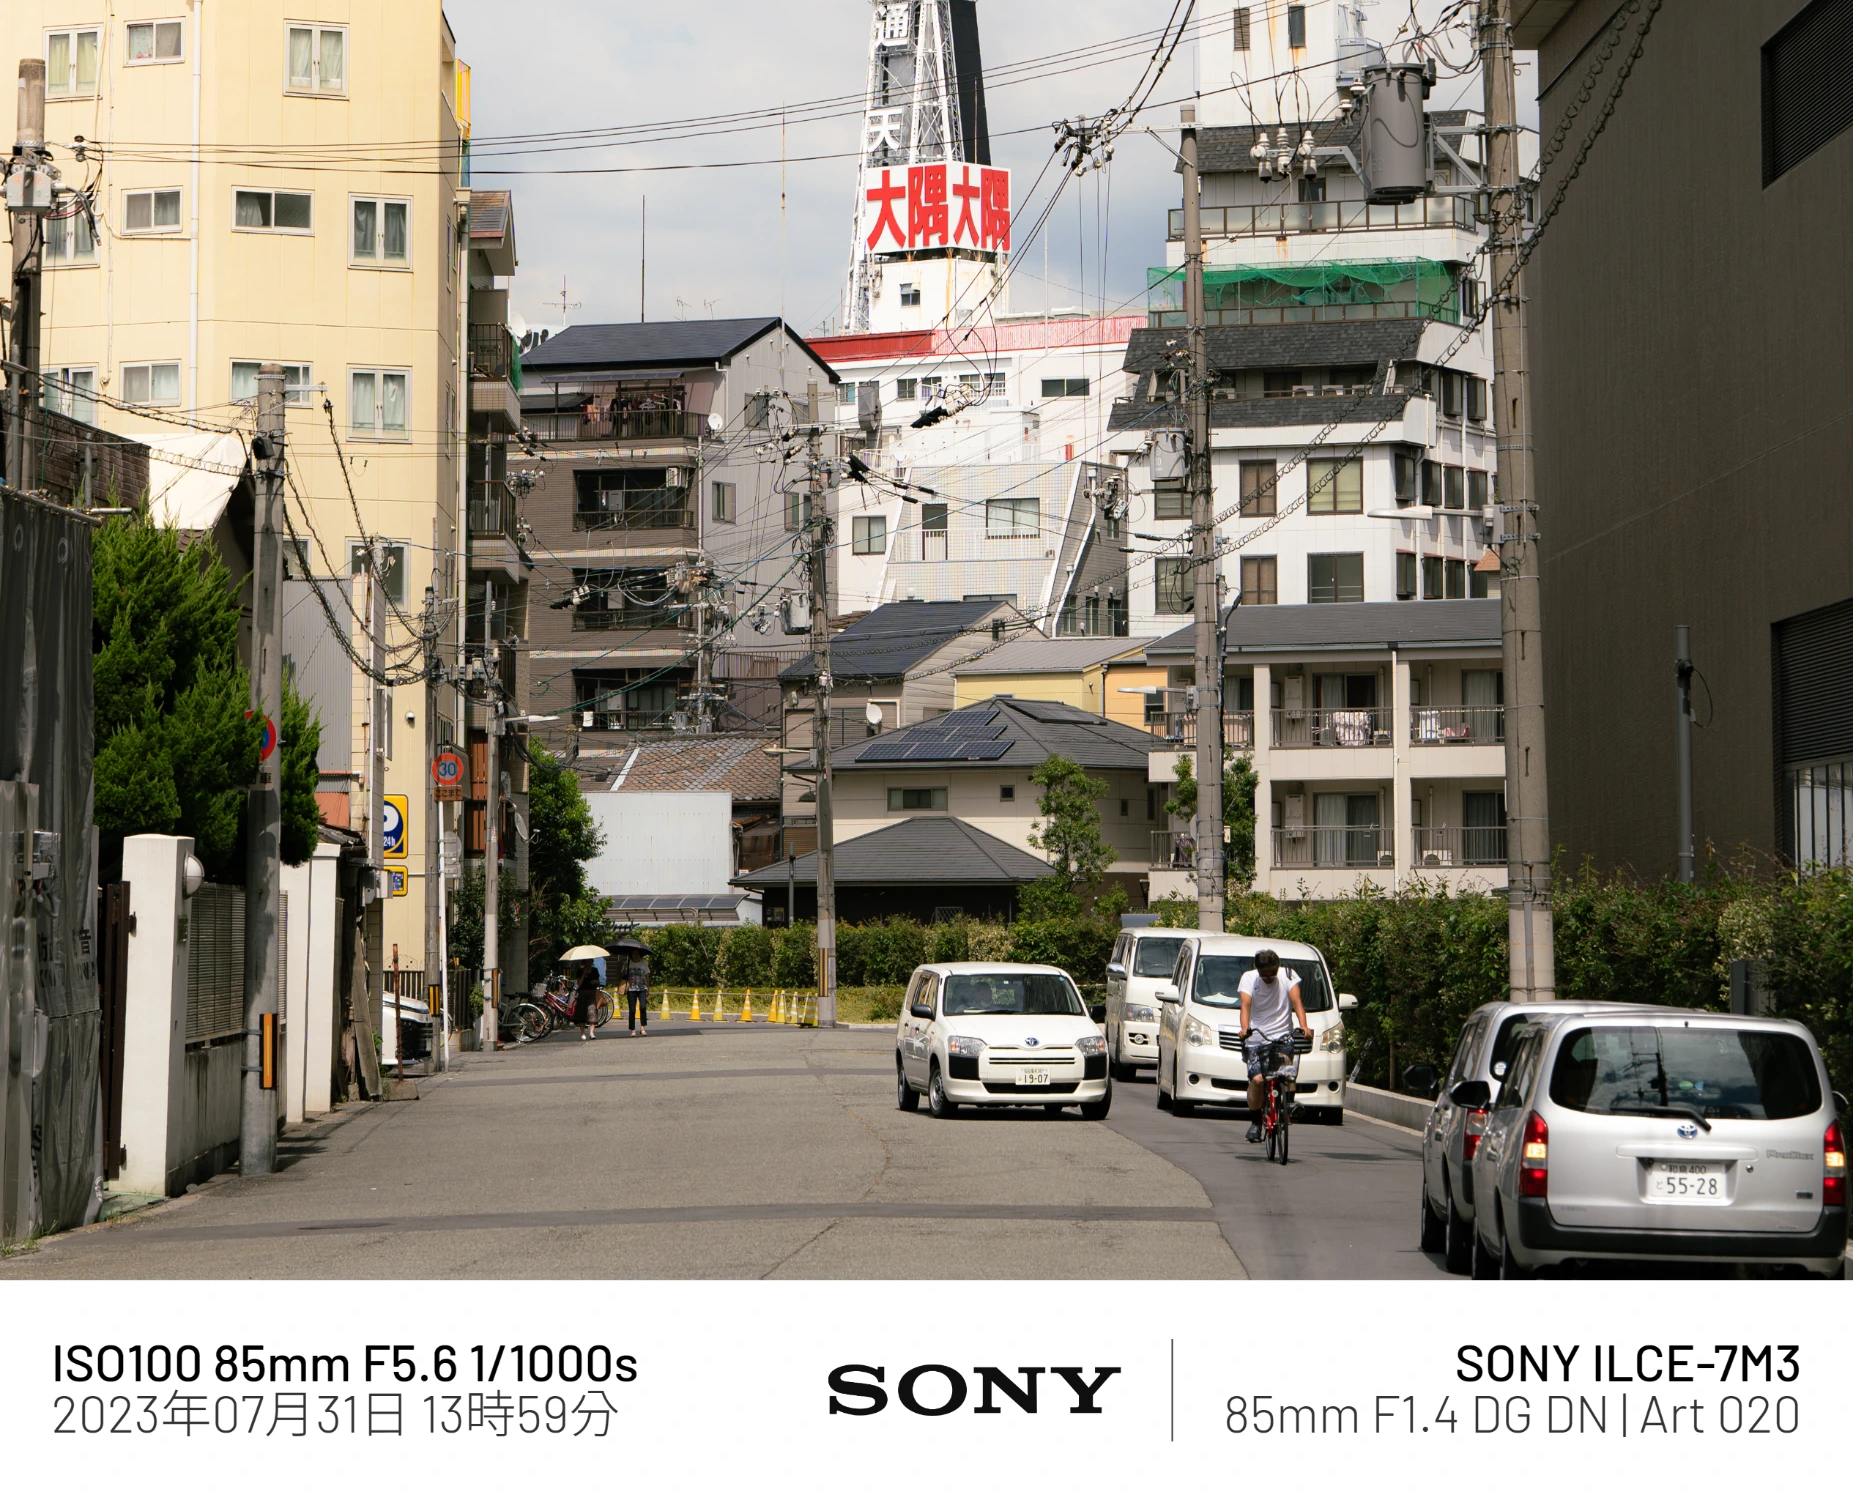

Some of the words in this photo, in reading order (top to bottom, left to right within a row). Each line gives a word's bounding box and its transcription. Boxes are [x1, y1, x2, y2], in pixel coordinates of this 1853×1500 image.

[866, 164, 949, 251] 大隅
[952, 165, 1011, 251] 大隅
[438, 762, 457, 777] 30
[435, 789, 462, 798] ここまで
[1024, 1074, 1049, 1084] 19-07
[1667, 1177, 1717, 1195] 55-28
